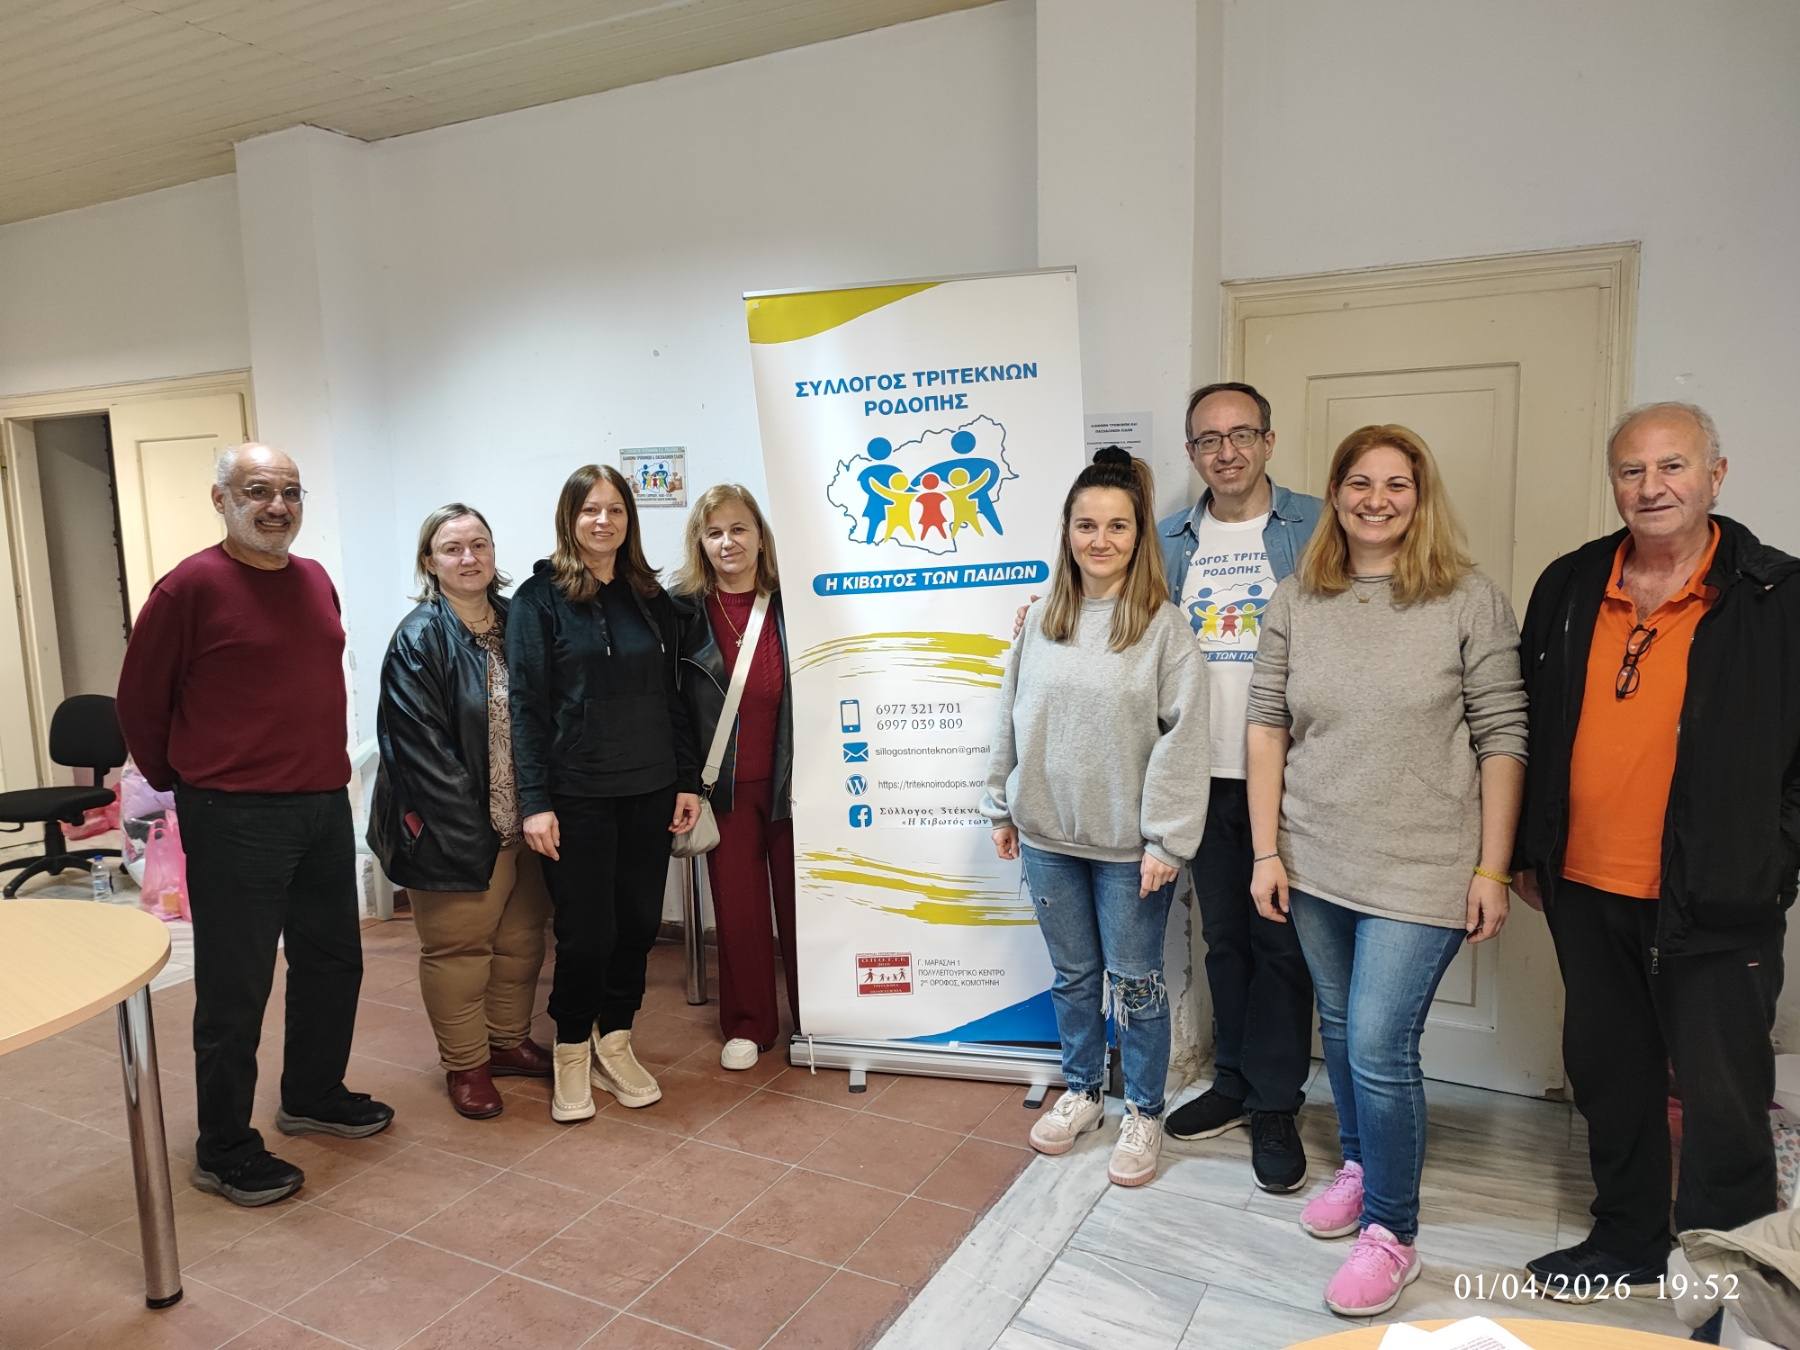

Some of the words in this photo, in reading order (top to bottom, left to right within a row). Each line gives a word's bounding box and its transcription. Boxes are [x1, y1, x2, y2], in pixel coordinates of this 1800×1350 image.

[794, 373, 908, 398] ΣΥΛΛΟΓΟΣ
[912, 362, 1038, 388] ΤΡΙΤΕΚΝΩΝ
[864, 393, 969, 417] ΡΟΔΟΠΗΣ
[1203, 565, 1261, 577] ΡΟΔΟΠΗΣ
[825, 578, 838, 591] Η
[842, 573, 917, 590] ΚΙΒΩΤΟΣ
[922, 570, 958, 585] ΤΩΝ
[963, 564, 1037, 583] ΠΑΙΔΙΩΝ
[1215, 652, 1237, 660] ΤΩΝ
[875, 704, 906, 715] 6977
[911, 703, 933, 714] 321
[938, 702, 962, 714] 701
[876, 719, 907, 731] 6997
[911, 718, 935, 730] 039
[939, 718, 963, 729] 809
[879, 807, 934, 817] Σύλλογος
[920, 817, 964, 827] Κιβωτός
[924, 959, 956, 967] ΜΑΡΑΣΛΗ
[978, 968, 1006, 976] ΚΕΝΤΡΟ
[961, 979, 1000, 987] ΚΟΜΟΤΗΝΗ
